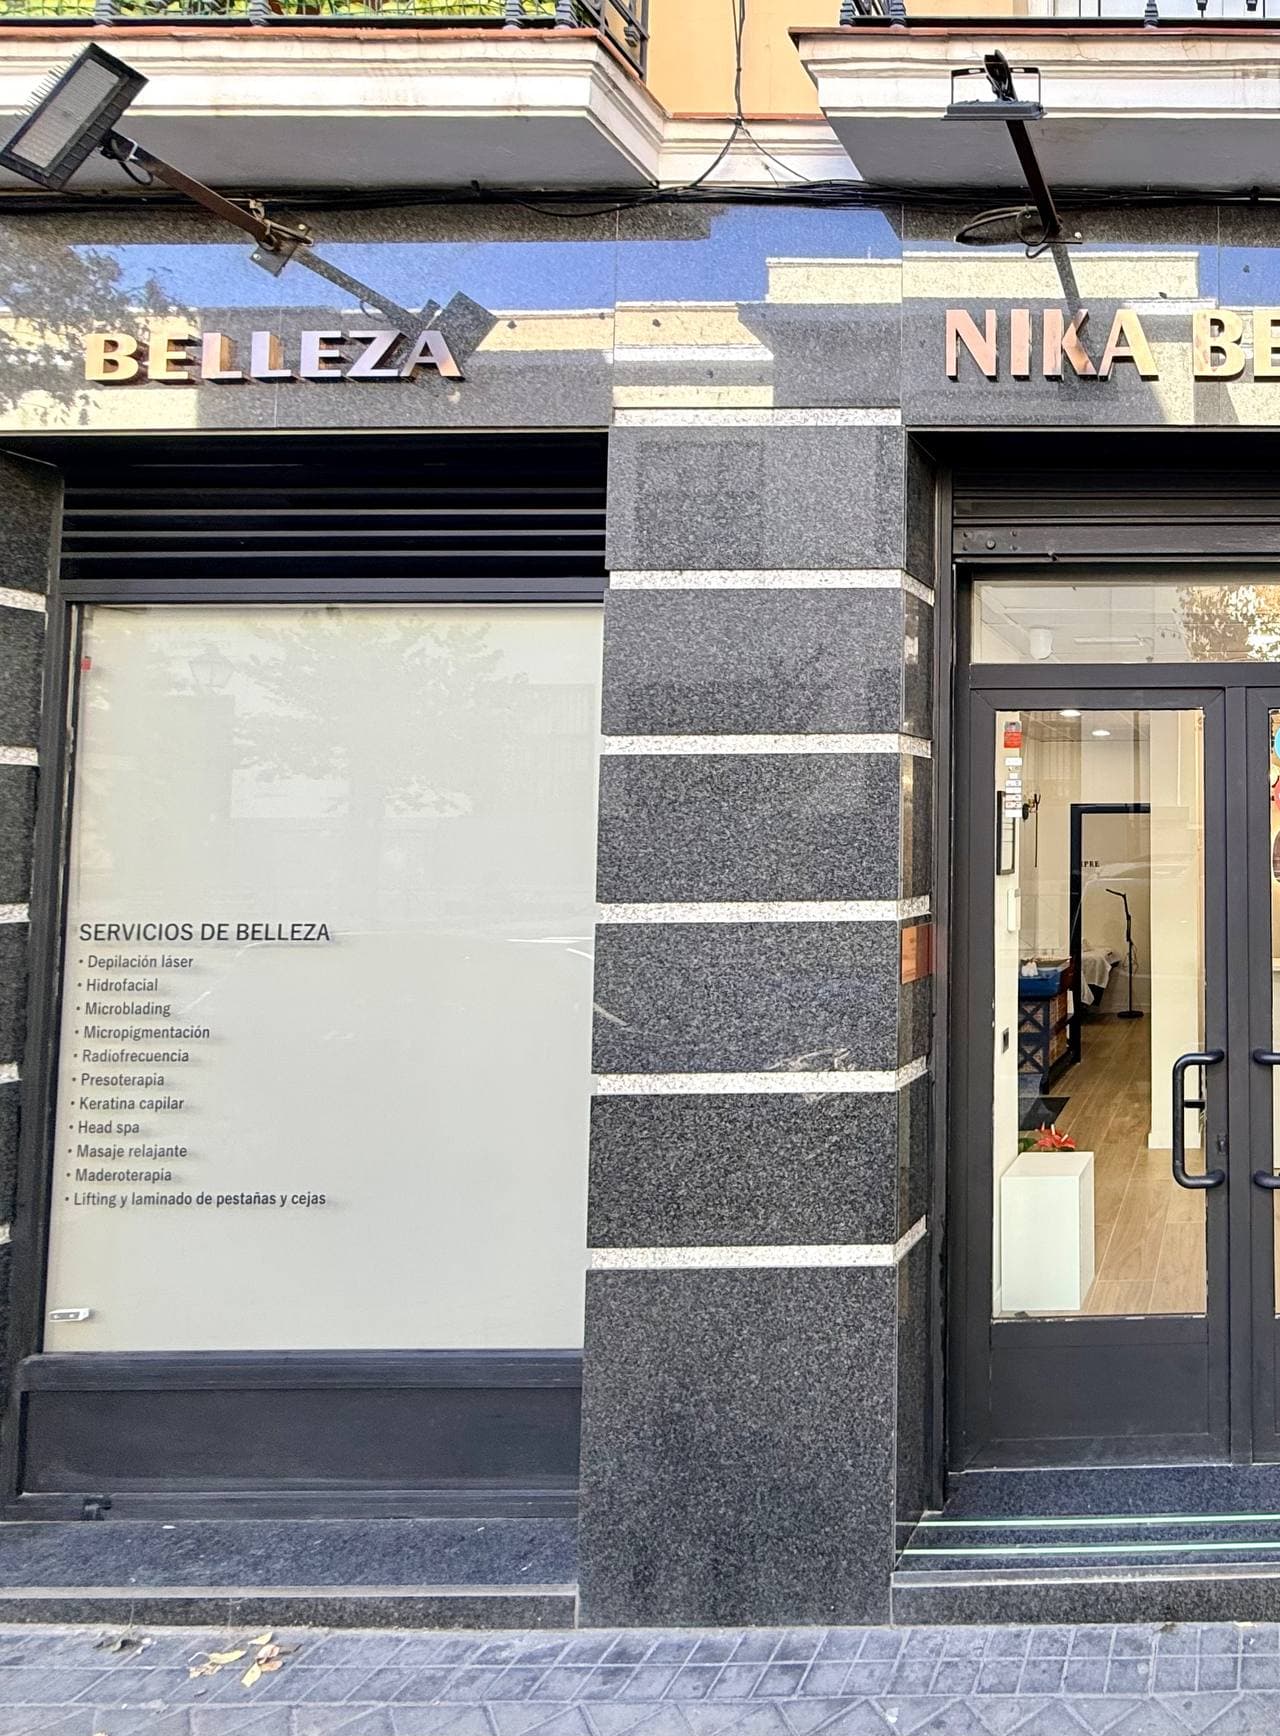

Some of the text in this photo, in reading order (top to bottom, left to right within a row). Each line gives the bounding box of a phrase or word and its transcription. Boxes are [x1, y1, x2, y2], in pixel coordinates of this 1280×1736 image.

[945, 308, 1159, 381] NIKA
[84, 329, 466, 382] BELLEZA
[79, 923, 331, 941] SERVICIOS DE BELLEZA
[88, 954, 194, 970] Depilación láser
[86, 977, 158, 992] Hidrofacial
[85, 1001, 171, 1017] Microblading
[83, 1025, 210, 1041] Micropigmentación
[82, 1049, 190, 1063] Radiofrecuencia
[81, 1072, 165, 1088] Presoterapia
[79, 1096, 185, 1112] Keratina capilar
[78, 1120, 140, 1137] Head spa
[76, 1144, 188, 1160] Masaje relajante
[75, 1167, 172, 1183] Maderoterapia
[74, 1191, 326, 1208] Lifting y laminado de pestañas y cejas
